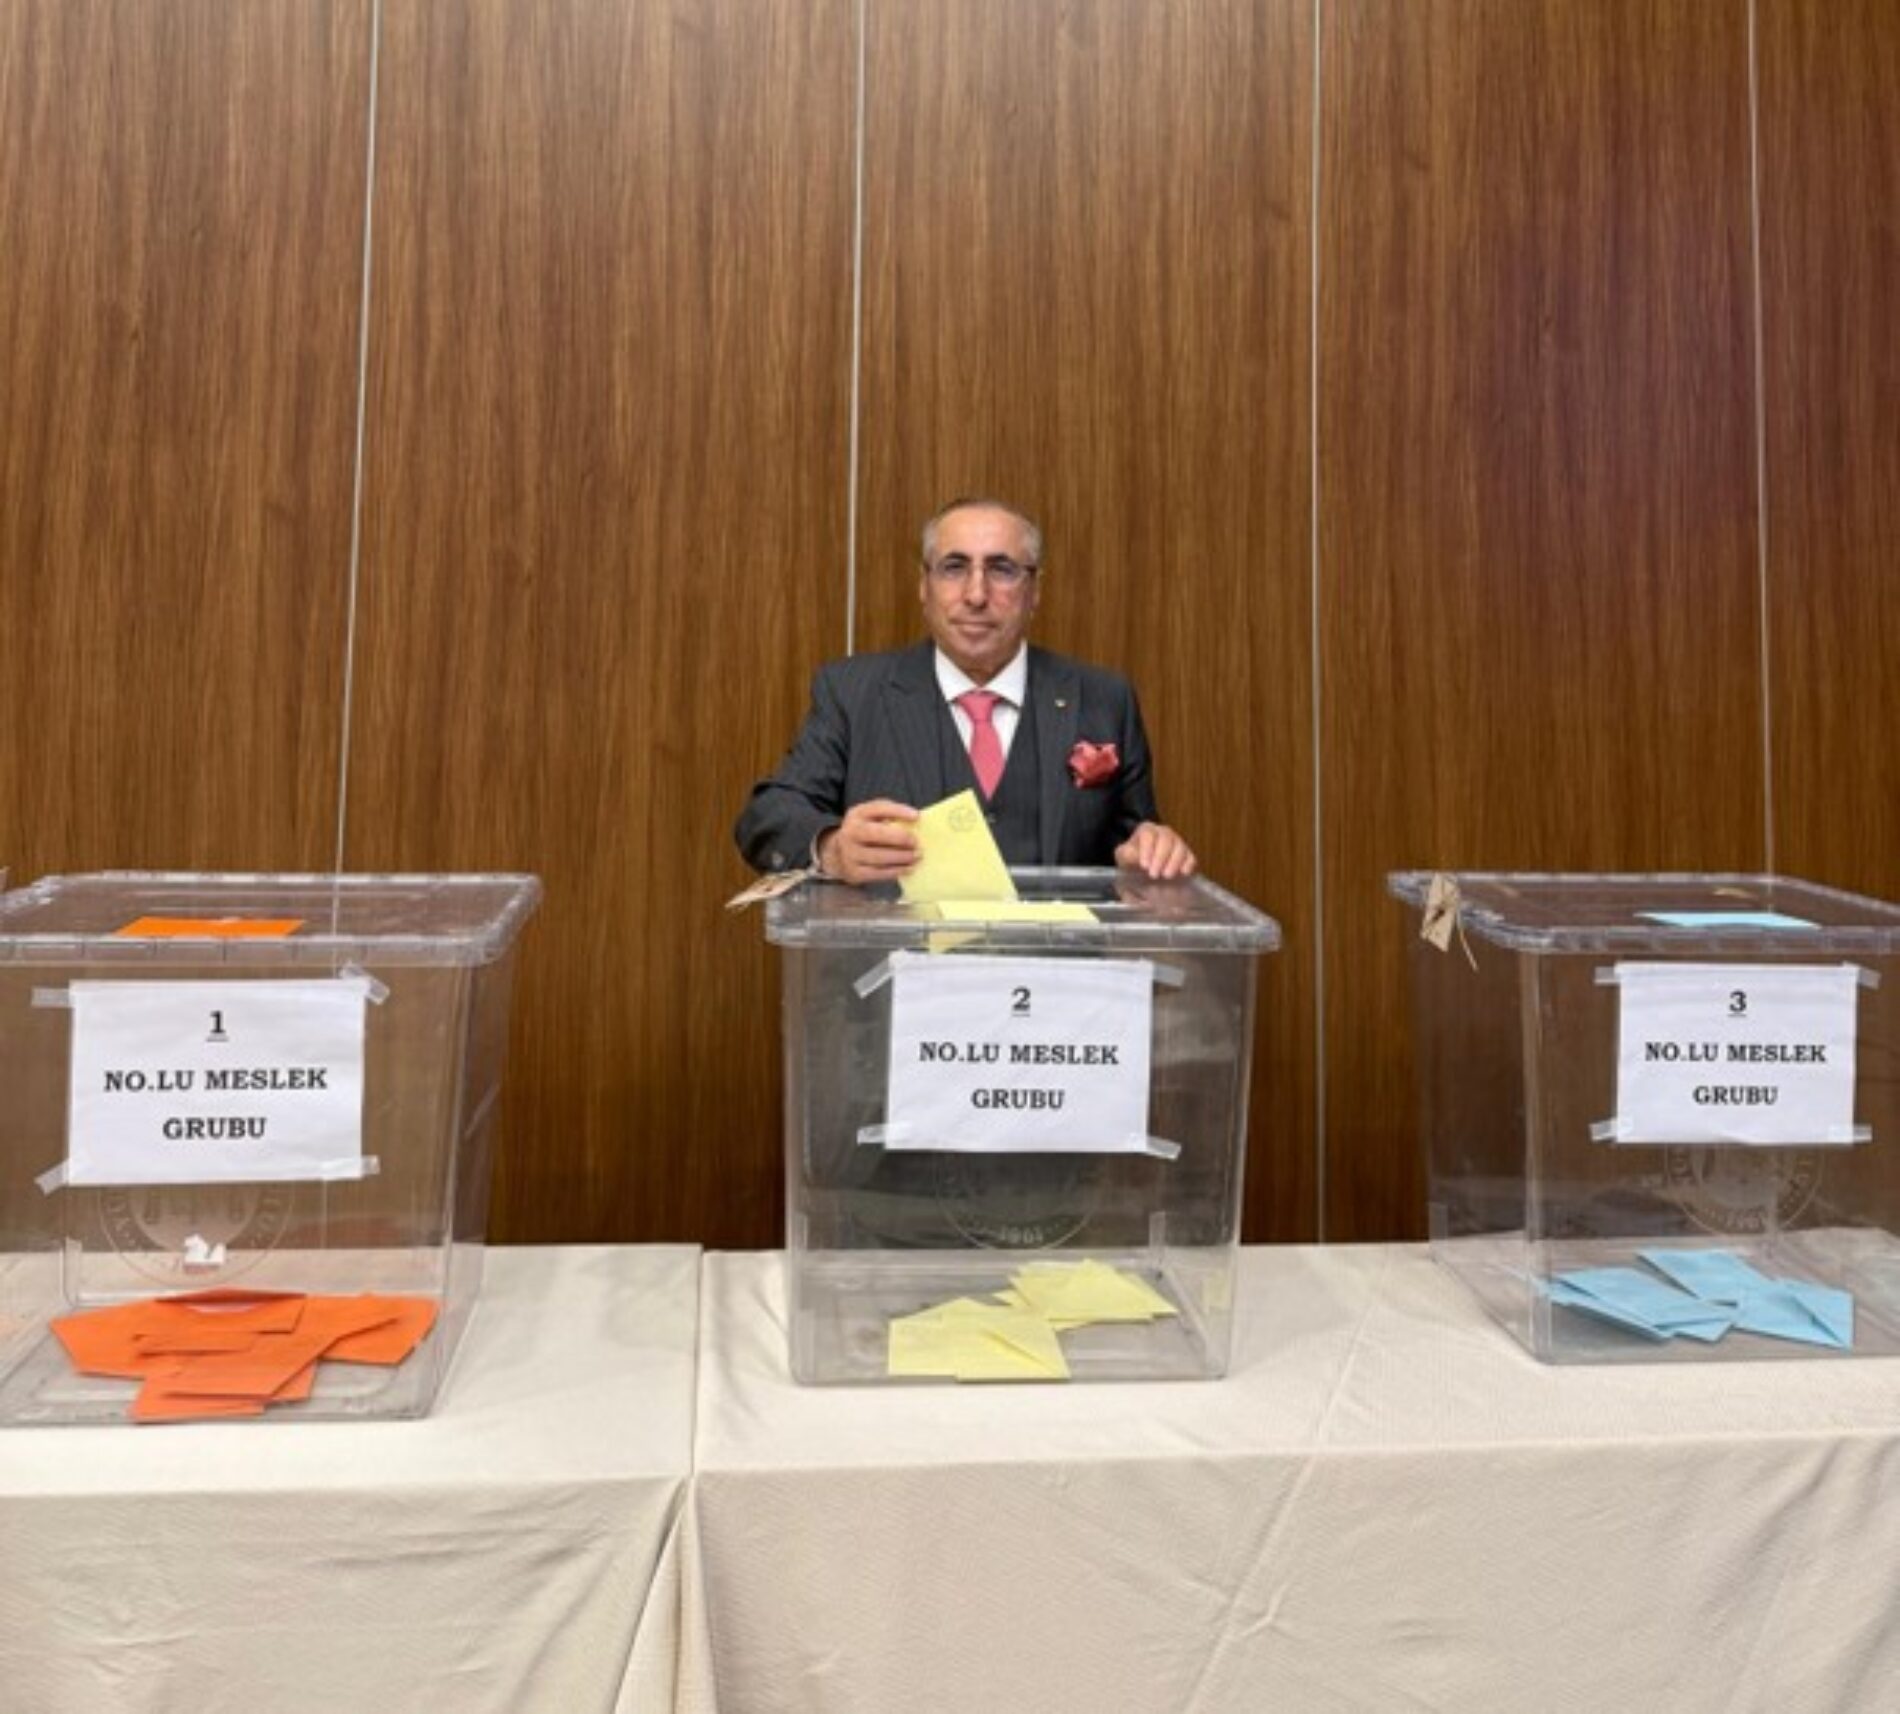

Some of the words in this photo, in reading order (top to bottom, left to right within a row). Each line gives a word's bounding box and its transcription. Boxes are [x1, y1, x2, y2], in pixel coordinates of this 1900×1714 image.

[1012, 986, 1031, 1012] 2
[1729, 990, 1747, 1015] 3
[208, 1010, 226, 1036] 1
[919, 1041, 1000, 1063] NO.LU
[1010, 1044, 1120, 1066] MESLEK
[1645, 1041, 1719, 1062] NO.LU
[1727, 1043, 1827, 1063] MESLEK
[104, 1069, 195, 1092] NO.LU
[205, 1068, 327, 1091] MESLEK
[970, 1088, 1065, 1110] GRUBU
[1692, 1085, 1778, 1106] GRUBU
[162, 1117, 267, 1140] GRUBU
